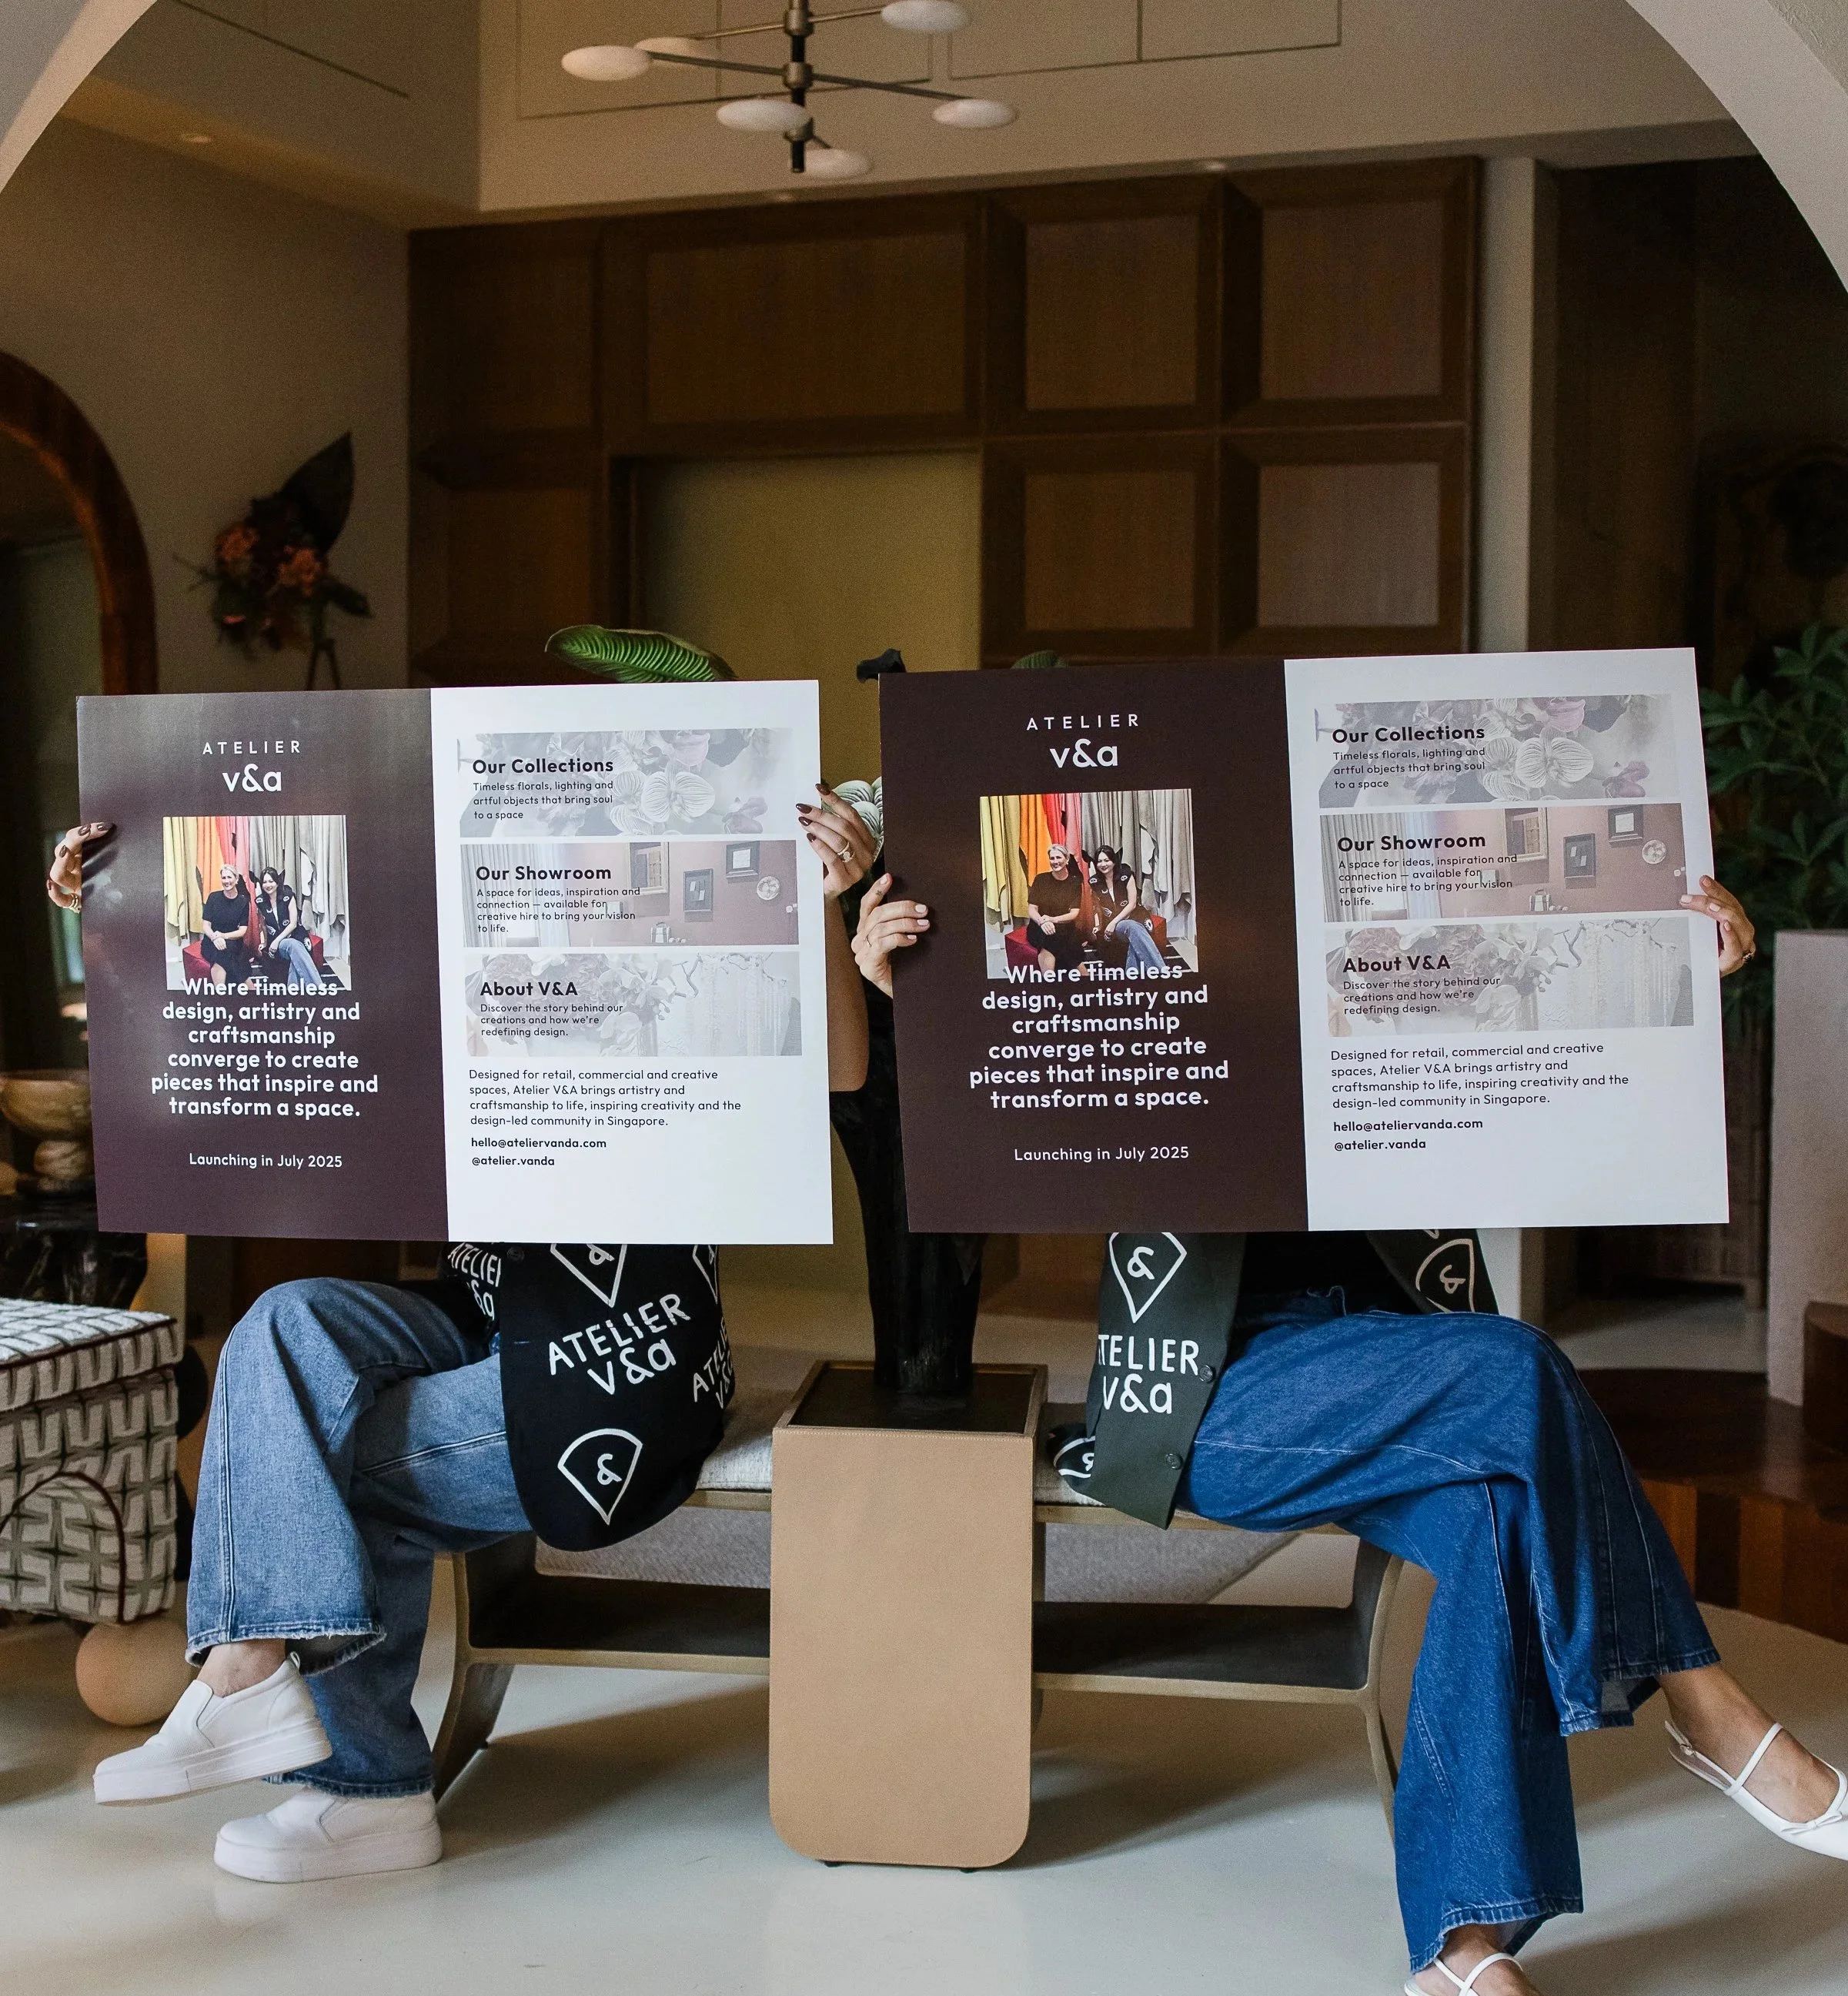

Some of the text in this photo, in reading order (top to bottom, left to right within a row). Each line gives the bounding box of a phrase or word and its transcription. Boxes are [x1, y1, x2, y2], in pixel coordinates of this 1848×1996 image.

[1026, 714, 1139, 731] ATELIER
[1332, 725, 1485, 744] Our Collections
[202, 740, 300, 755] ATELIER
[1049, 737, 1118, 768] v&a
[1332, 747, 1485, 761] Timeless florals, lighting and
[473, 757, 613, 774] Our Collections
[1333, 761, 1485, 776] artful objects that bring soul
[222, 763, 282, 792] v&a
[1334, 781, 1346, 789] to
[1358, 781, 1389, 791] space
[1337, 834, 1486, 852] Our Showroom
[476, 865, 611, 881] Our Showroom
[476, 886, 640, 898] A space for ideas, inspiration and
[477, 911, 636, 922] creative hire to bring your vision
[477, 923, 510, 934] to life.
[1004, 961, 1183, 985] Where timeless
[1342, 955, 1451, 974] About V&A
[182, 977, 338, 997] Where timeless
[480, 981, 579, 996] About V&A
[981, 984, 1208, 1013] design, artistry and
[162, 1001, 360, 1025] design, artistry and
[480, 1004, 523, 1012] Discover
[525, 1004, 541, 1012] the
[543, 1004, 569, 1015] story
[571, 1003, 604, 1012] behind
[480, 1015, 600, 1025] creations and how we're
[1011, 1011, 1180, 1035] craftsmanship
[188, 1025, 336, 1049] craftsmanship
[481, 1027, 569, 1038] redefining design.
[988, 1036, 1207, 1062] converge to create
[1331, 1043, 1604, 1062] Designed for retail, commercial and creative
[167, 1050, 359, 1072] converge to create
[469, 1069, 718, 1082] Designed for retail, commercial and creative
[969, 1059, 1229, 1089] pieces that inspire and
[151, 1072, 379, 1097] pieces that inspire and
[470, 1085, 685, 1098] spaces, Atelier V&A brings artistry and
[1332, 1074, 1629, 1093] craftsmanship to life, inspiring creativity and the
[169, 1096, 360, 1121] transform a space.
[470, 1100, 741, 1113] craftsmanship to life, inspiring creativity and the
[990, 1088, 1209, 1111] transform a space.
[1332, 1094, 1550, 1111] design-led community in Singapore.
[470, 1115, 668, 1128] design-led community in Singapore.
[1333, 1118, 1483, 1132] hello@ateliervanda.com
[471, 1137, 607, 1148] hello@ateliervanda.com
[1334, 1138, 1426, 1152] @atelier.vanda
[189, 1152, 343, 1170] Launching in July 2025
[472, 1155, 555, 1166] @atelier.vanda
[1014, 1145, 1189, 1163] Launching in July 2025
[466, 1279, 495, 1321] &a
[549, 1293, 691, 1376] ATELIER
[1098, 1334, 1199, 1376] TELIER
